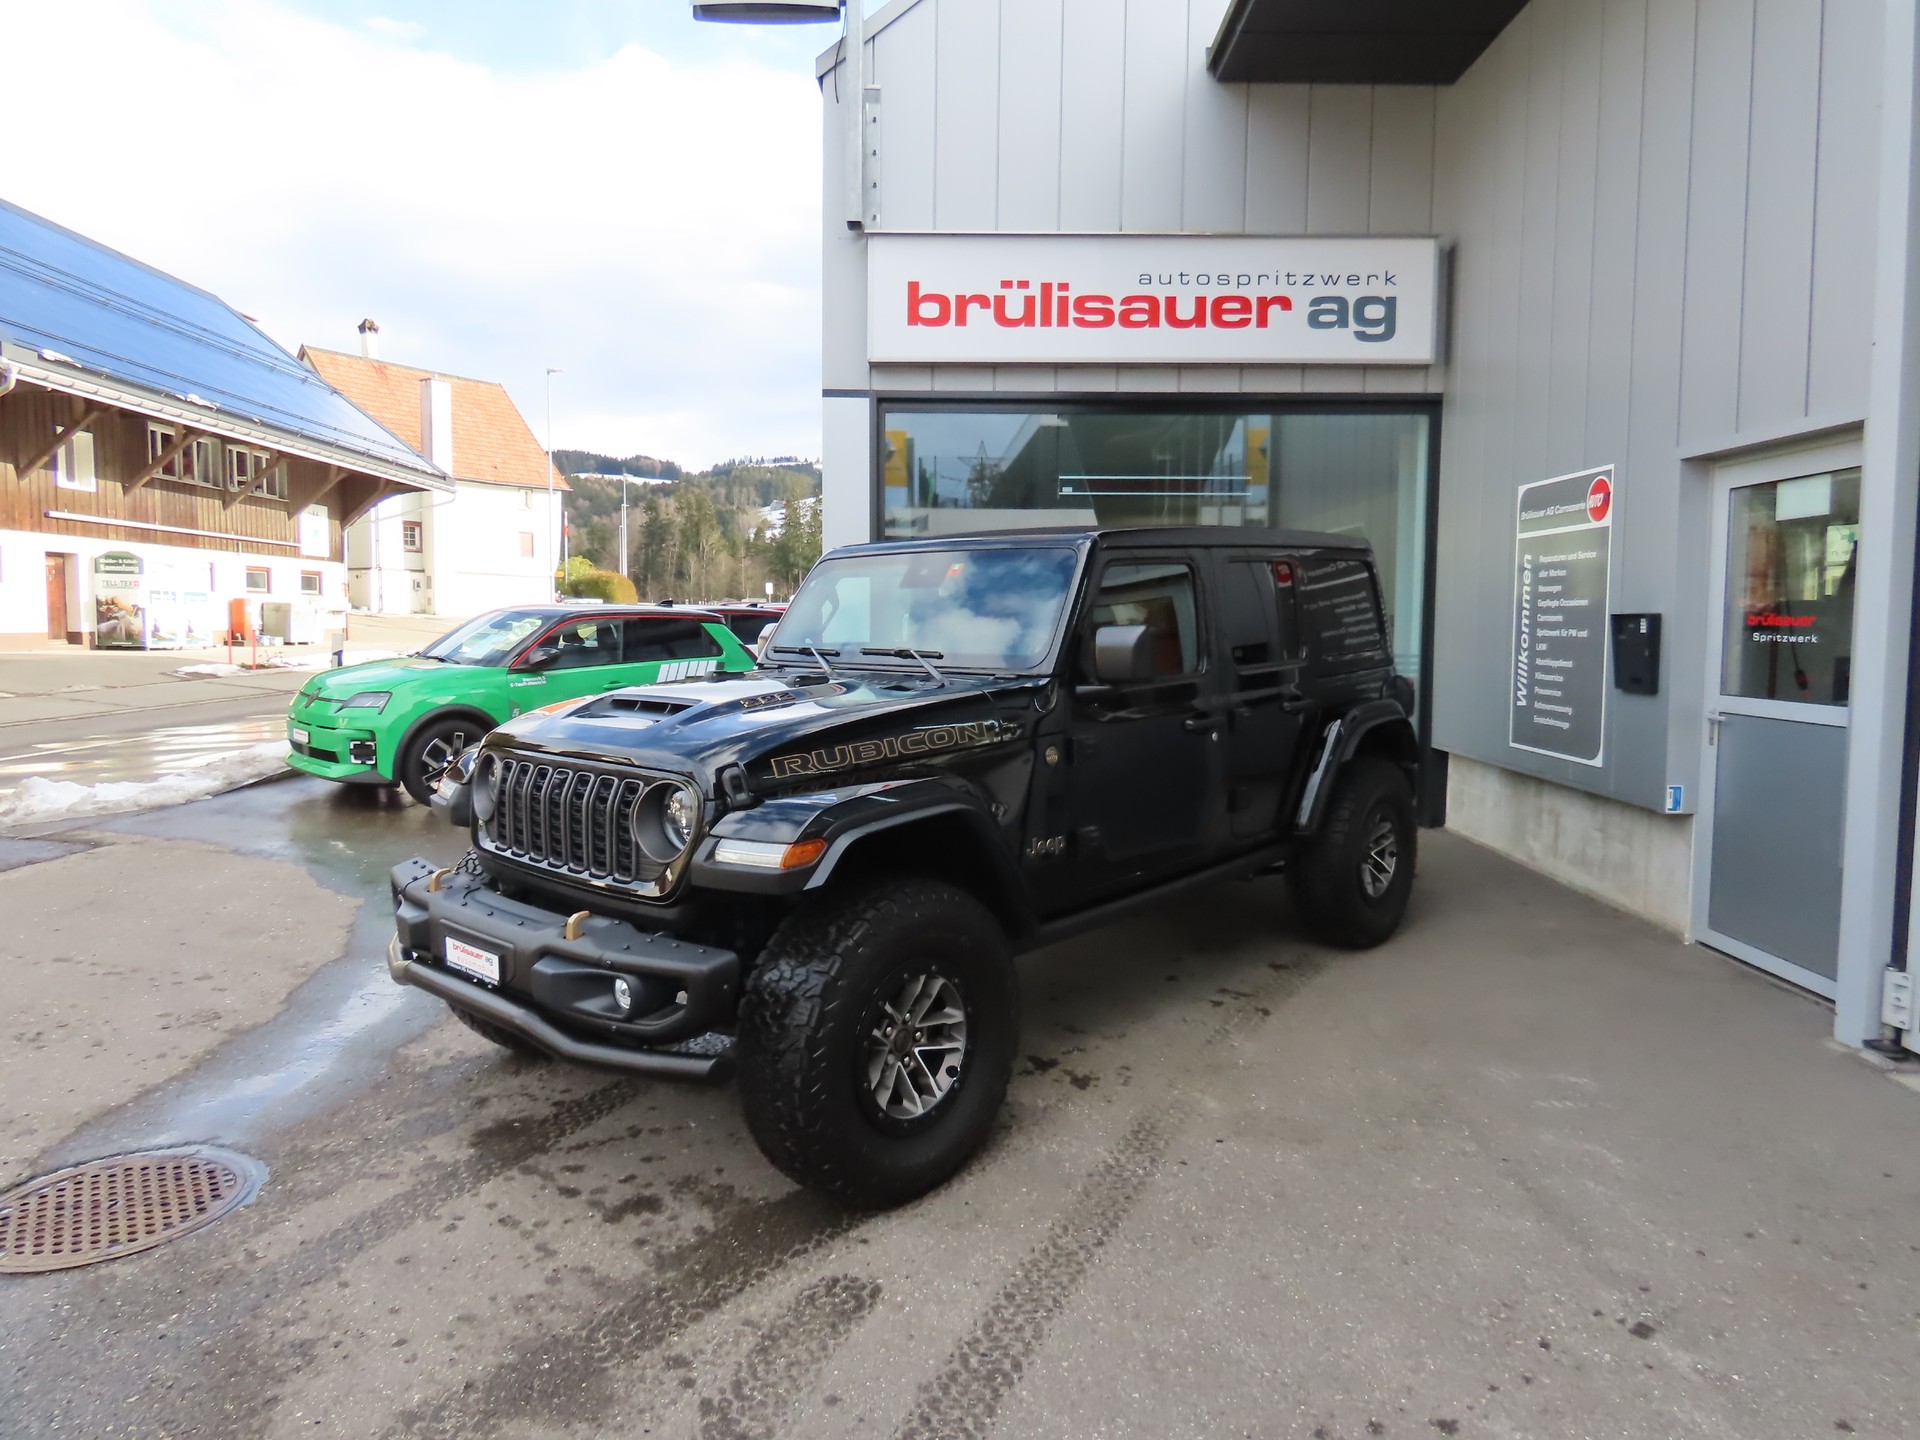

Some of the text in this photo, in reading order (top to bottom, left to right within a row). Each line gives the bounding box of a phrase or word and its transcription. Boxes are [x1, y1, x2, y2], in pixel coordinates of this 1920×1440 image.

[1138, 270, 1398, 289] autospritzwerk
[906, 279, 1397, 342] brülisauer ag
[1516, 554, 1532, 706] Willkommen
[1752, 632, 1818, 643] Spritzwerk
[771, 721, 987, 779] RUBICON
[1026, 834, 1066, 856] Jeep
